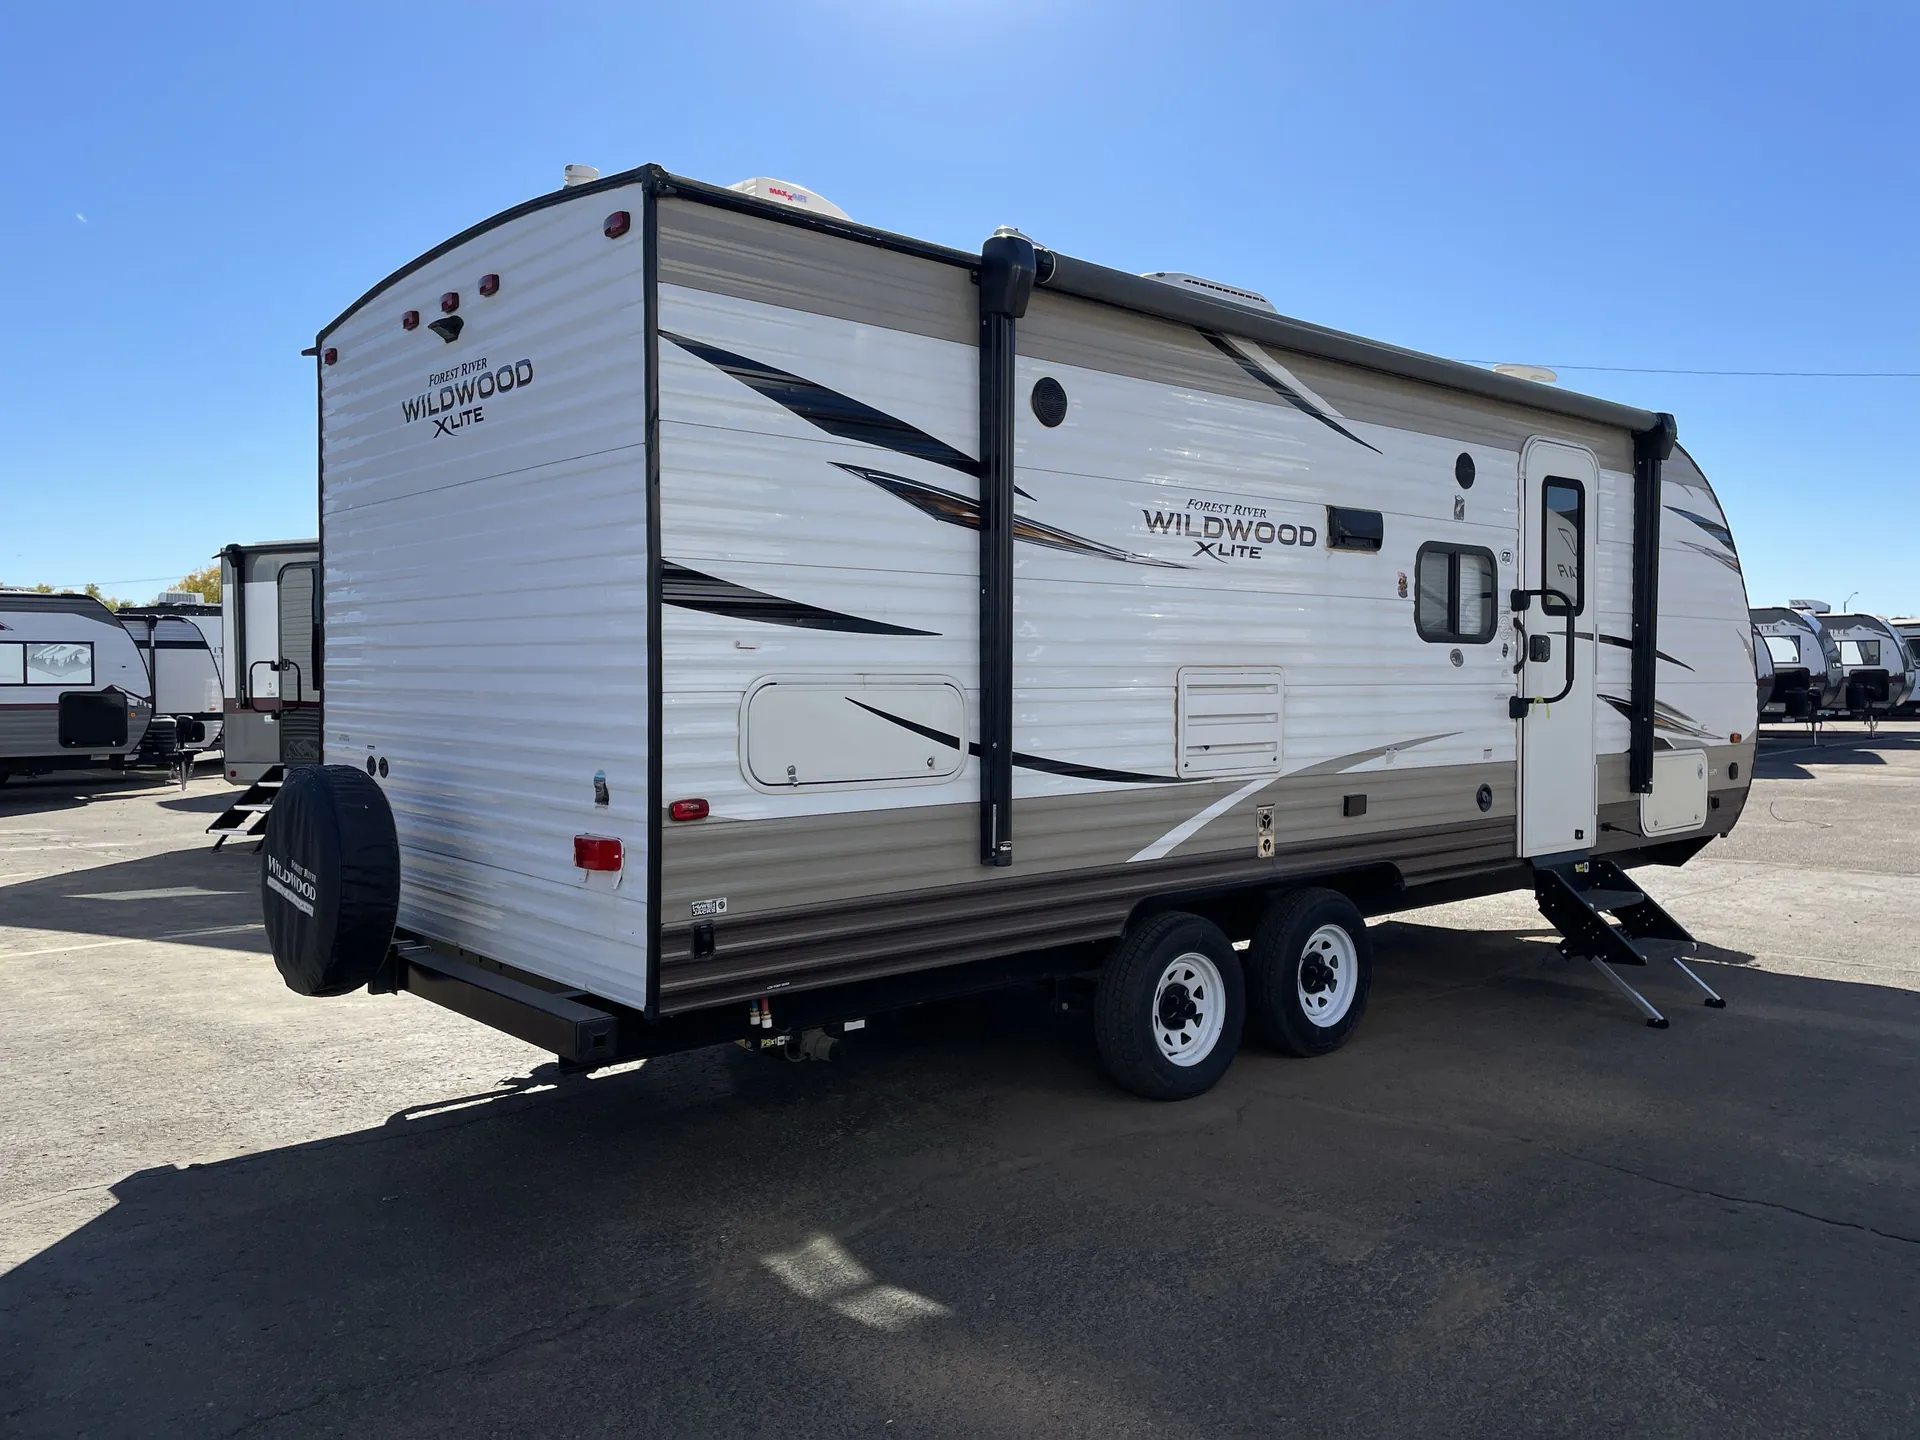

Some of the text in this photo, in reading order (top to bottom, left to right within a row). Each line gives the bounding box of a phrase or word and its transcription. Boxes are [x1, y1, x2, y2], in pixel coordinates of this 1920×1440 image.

[401, 358, 533, 423] WILDWOOD
[428, 357, 487, 387] FOREST RIVER
[1186, 498, 1267, 518] FOREST RIVER
[1142, 509, 1317, 547] WILDWOOD
[268, 854, 316, 901] WILDWOOD
